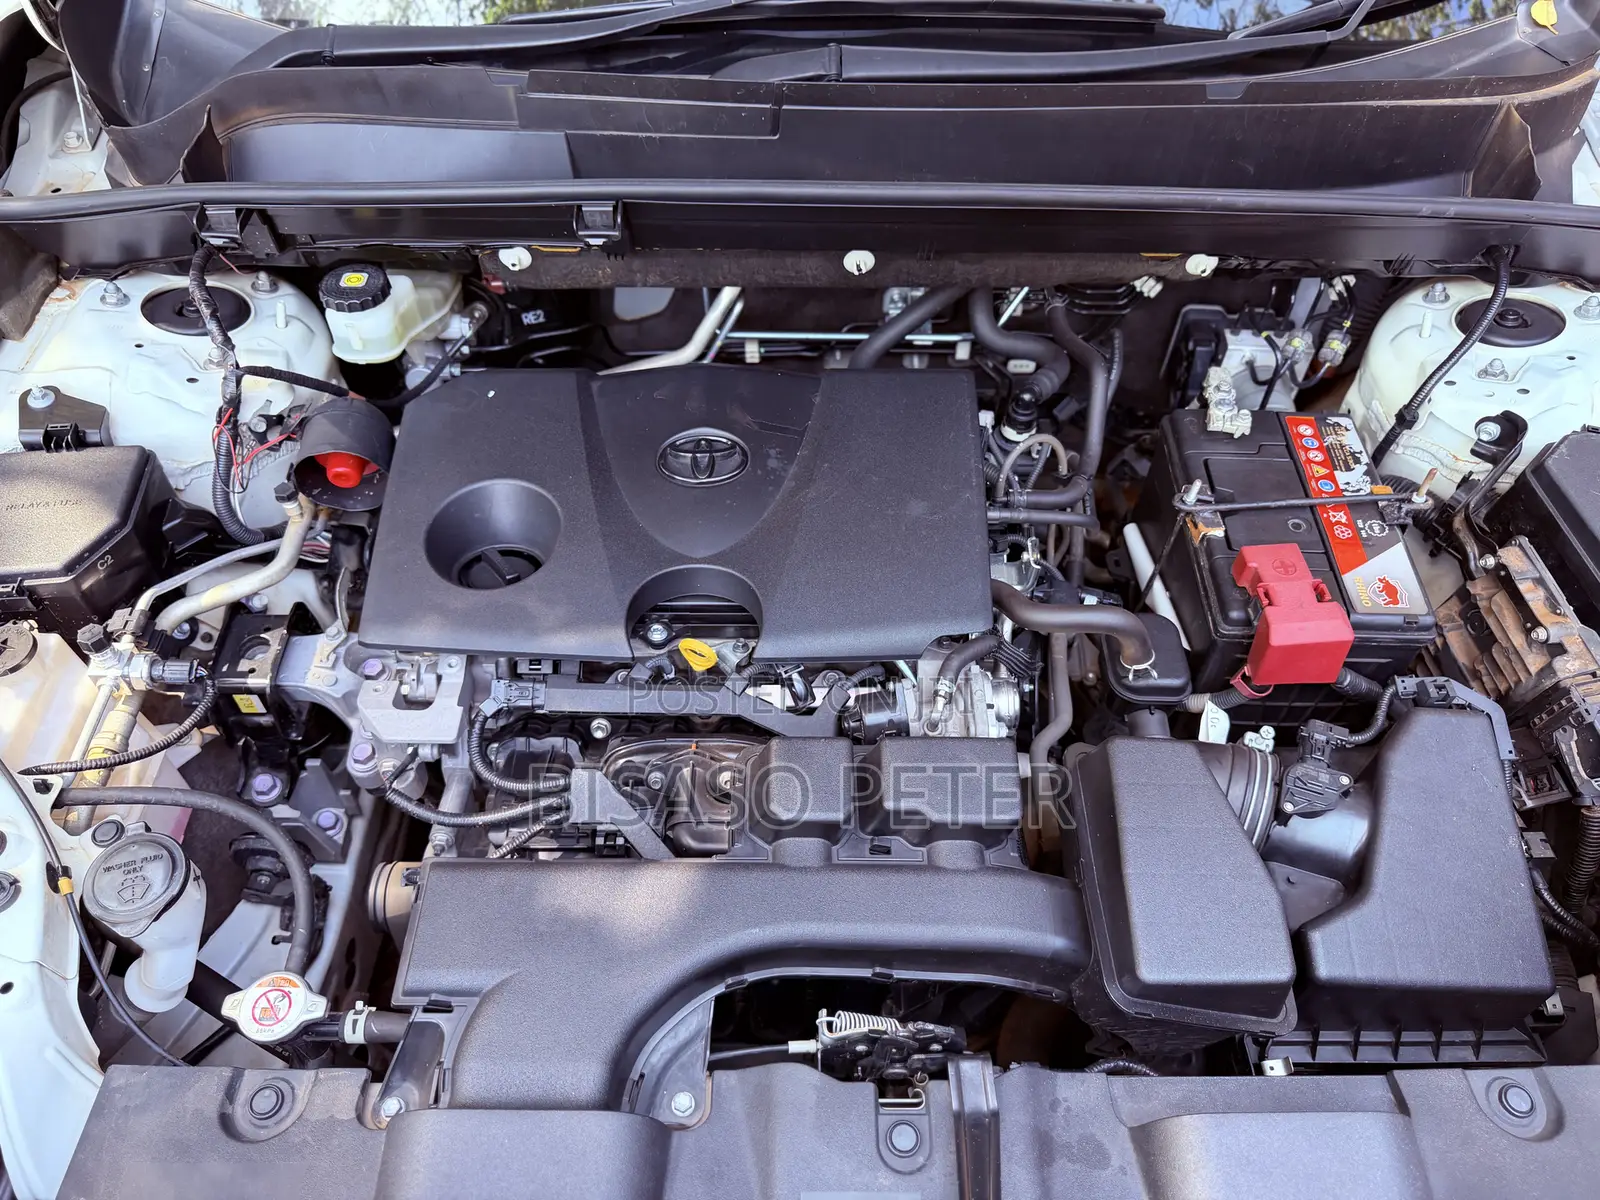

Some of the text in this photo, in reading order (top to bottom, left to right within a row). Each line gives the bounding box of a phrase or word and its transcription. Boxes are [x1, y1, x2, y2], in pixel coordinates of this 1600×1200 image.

[521, 309, 546, 326] RE2
[97, 554, 114, 570] C2
[1353, 575, 1372, 607] RHINO
[102, 853, 164, 874] WASHER FLUID
[122, 865, 144, 876] ONLY
